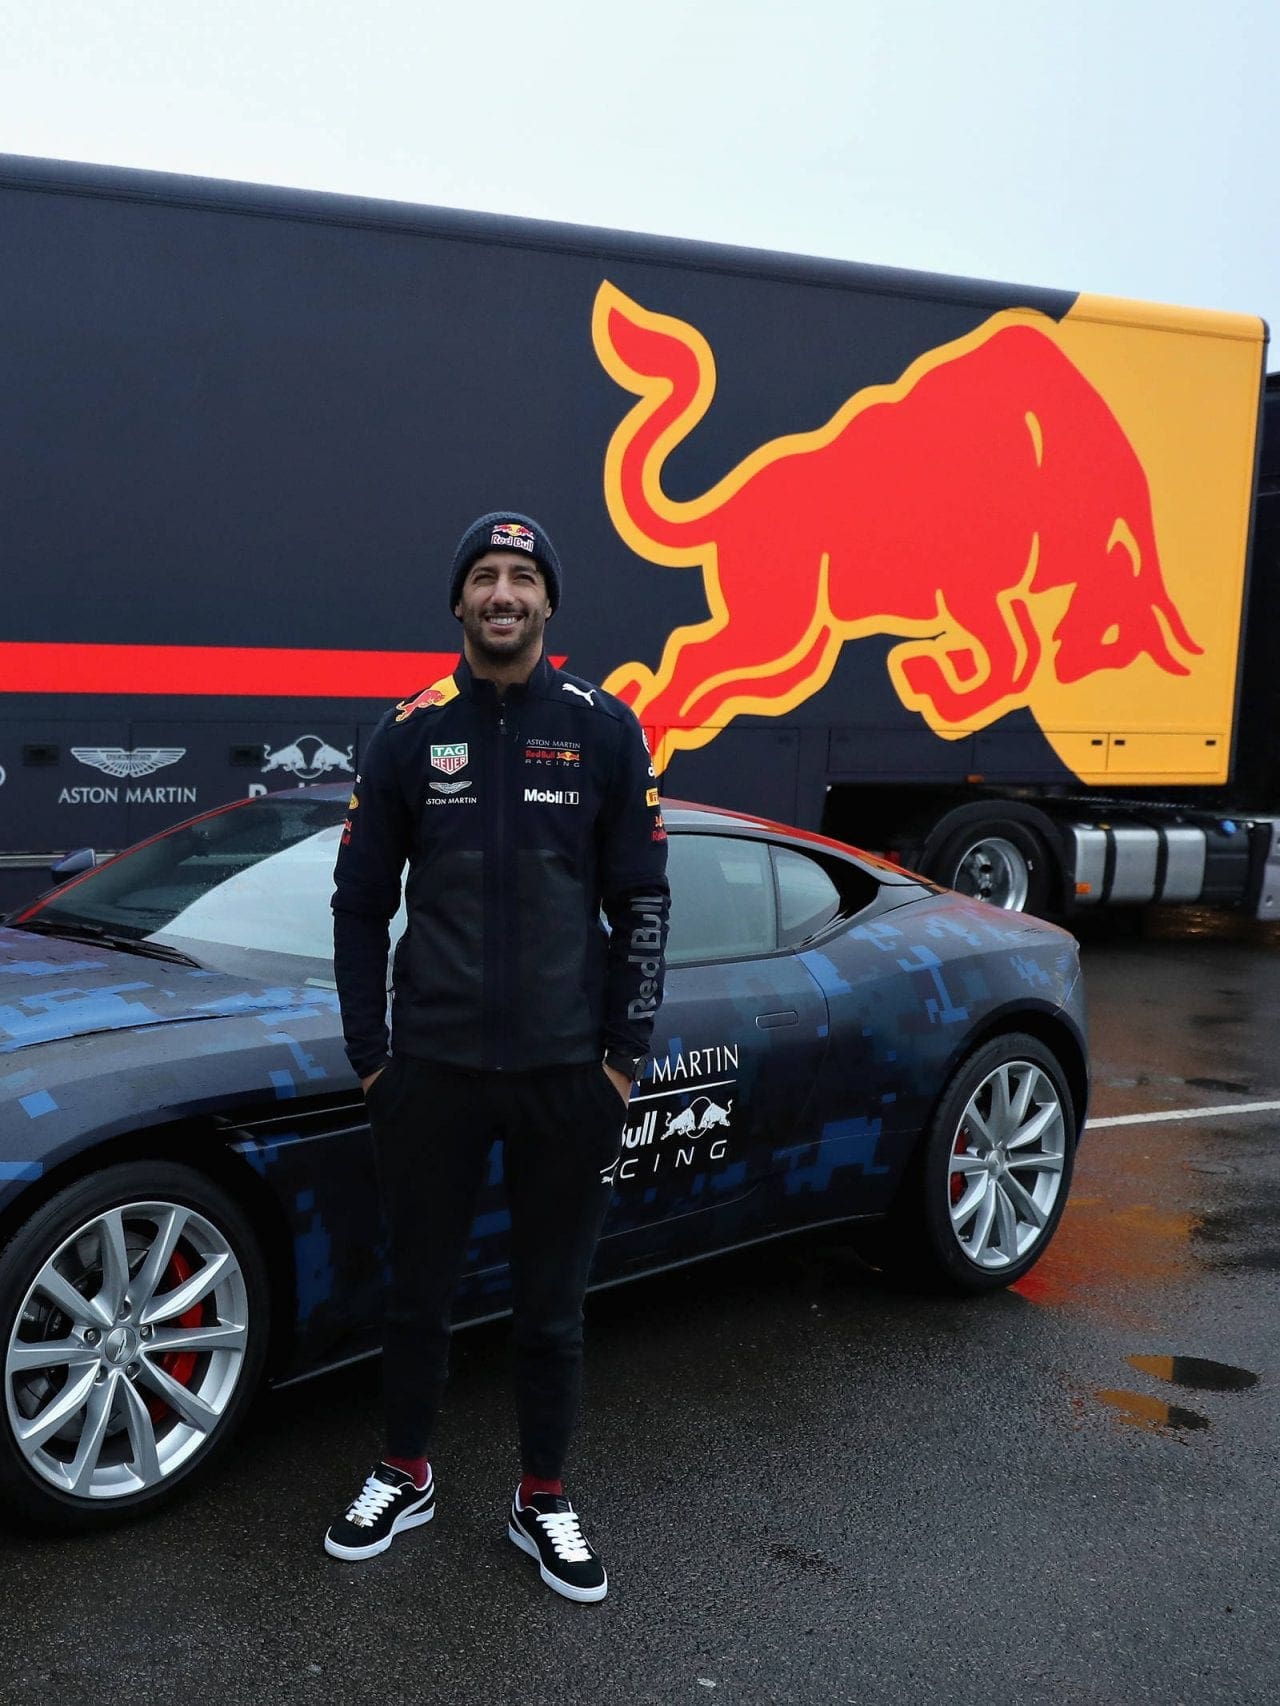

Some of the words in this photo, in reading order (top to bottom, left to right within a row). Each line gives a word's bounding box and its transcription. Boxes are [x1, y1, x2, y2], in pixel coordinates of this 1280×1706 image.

[491, 534, 513, 546] Red
[513, 537, 534, 552] Bull
[433, 746, 465, 757] TAG
[433, 757, 465, 772] HEUER
[525, 759, 580, 767] RACING
[58, 786, 119, 804] ASTON
[125, 786, 197, 804] MARTIN
[524, 788, 563, 804] Mobil
[630, 896, 664, 950] Bull
[627, 955, 661, 1020] Red
[652, 1043, 739, 1084] MARTIN
